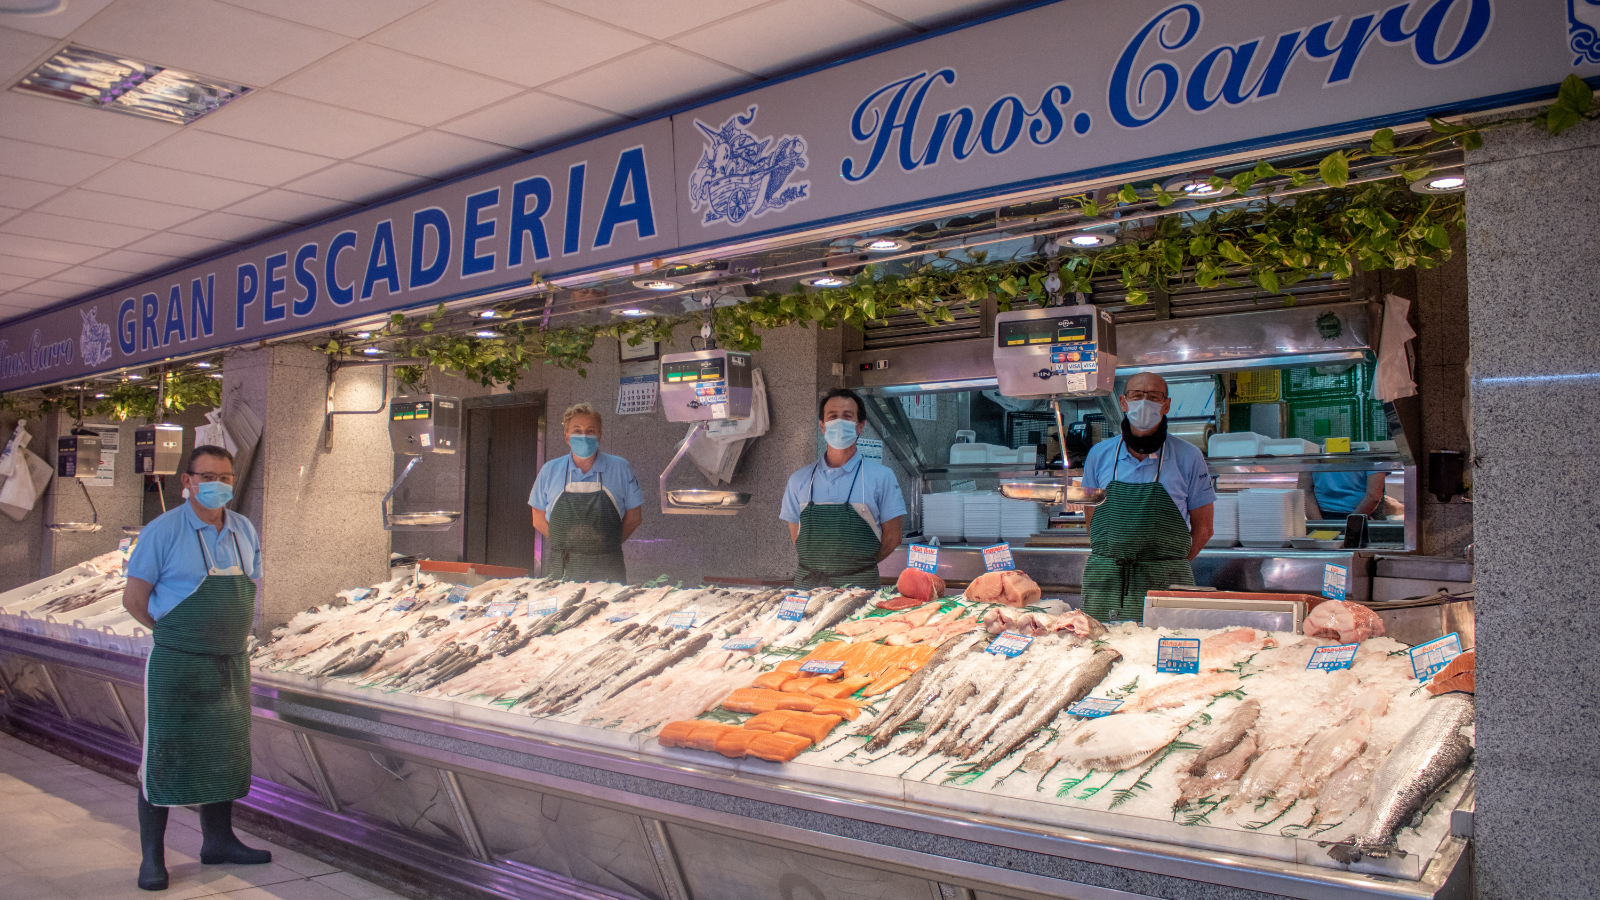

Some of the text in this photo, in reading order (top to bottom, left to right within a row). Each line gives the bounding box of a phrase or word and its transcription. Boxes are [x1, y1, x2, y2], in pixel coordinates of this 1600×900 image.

[842, 0, 1493, 183] Hnos. Carro
[118, 144, 657, 356] GRAN PESCADERIA
[29, 328, 74, 373] Carro
